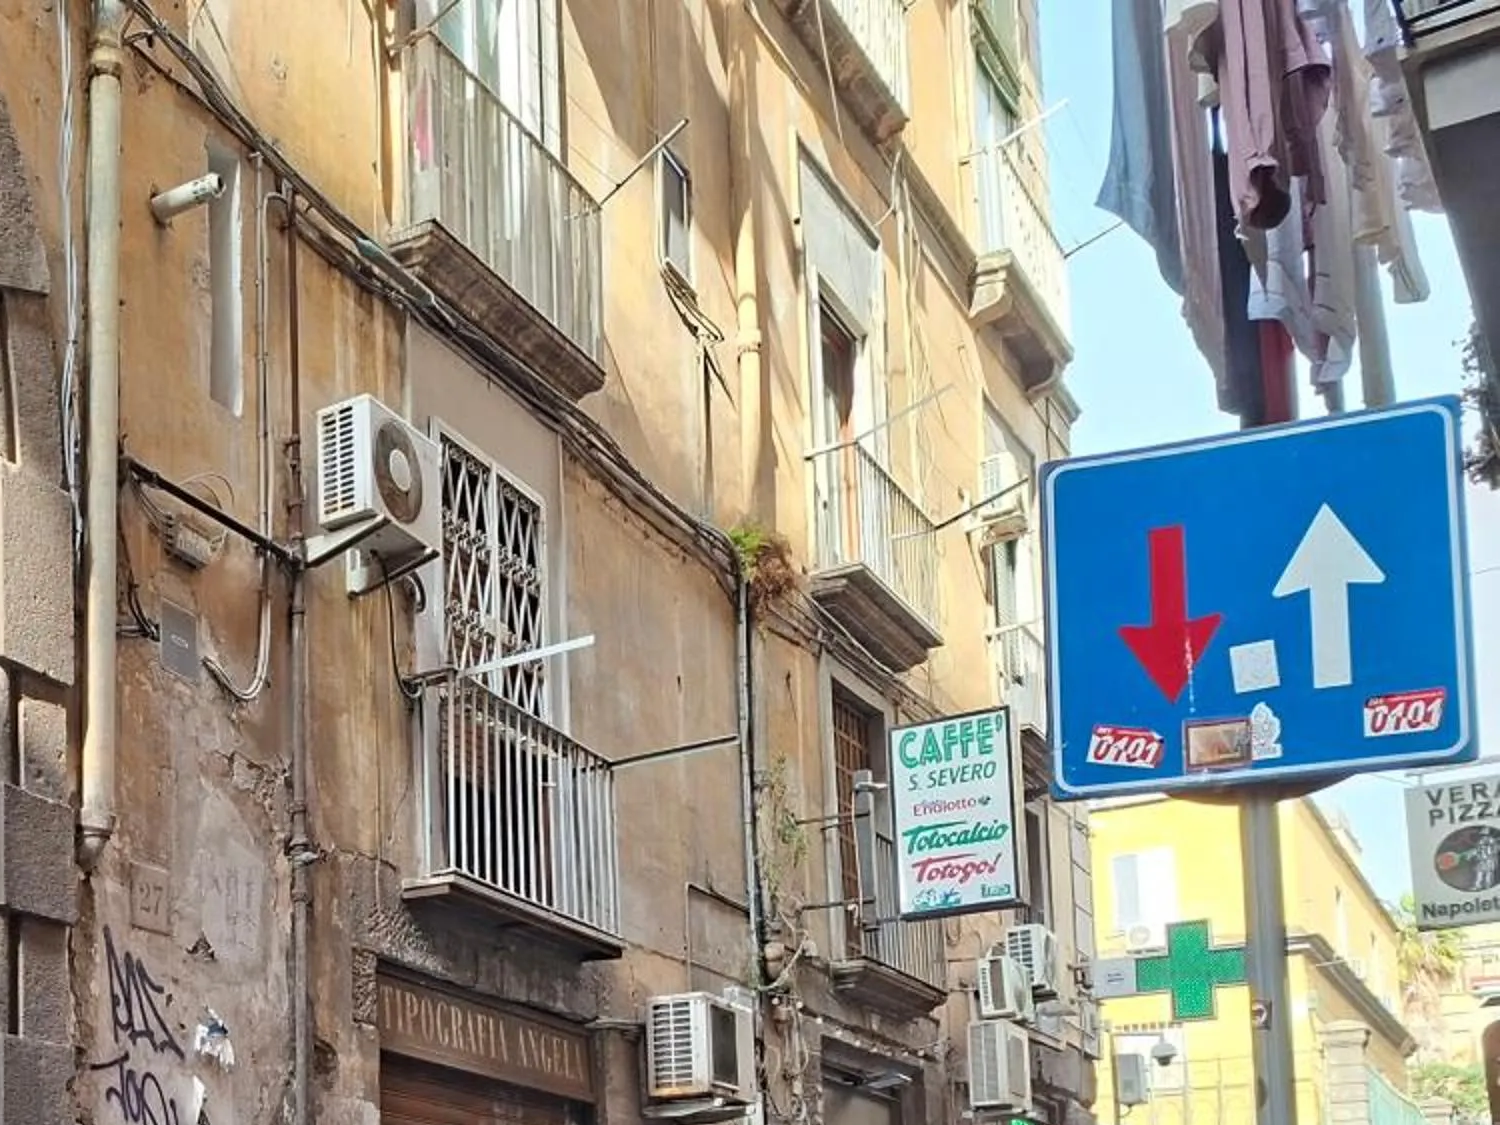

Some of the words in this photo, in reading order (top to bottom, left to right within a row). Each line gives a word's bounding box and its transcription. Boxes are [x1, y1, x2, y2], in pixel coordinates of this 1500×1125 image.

[899, 714, 1004, 769] CAFFE'
[927, 761, 997, 789] SEVERO
[1428, 801, 1500, 827] PIZZ
[902, 819, 1009, 855] Totocalcio
[379, 984, 509, 1063] TIPOGRAFIA
[518, 1026, 584, 1082] ANGELA
